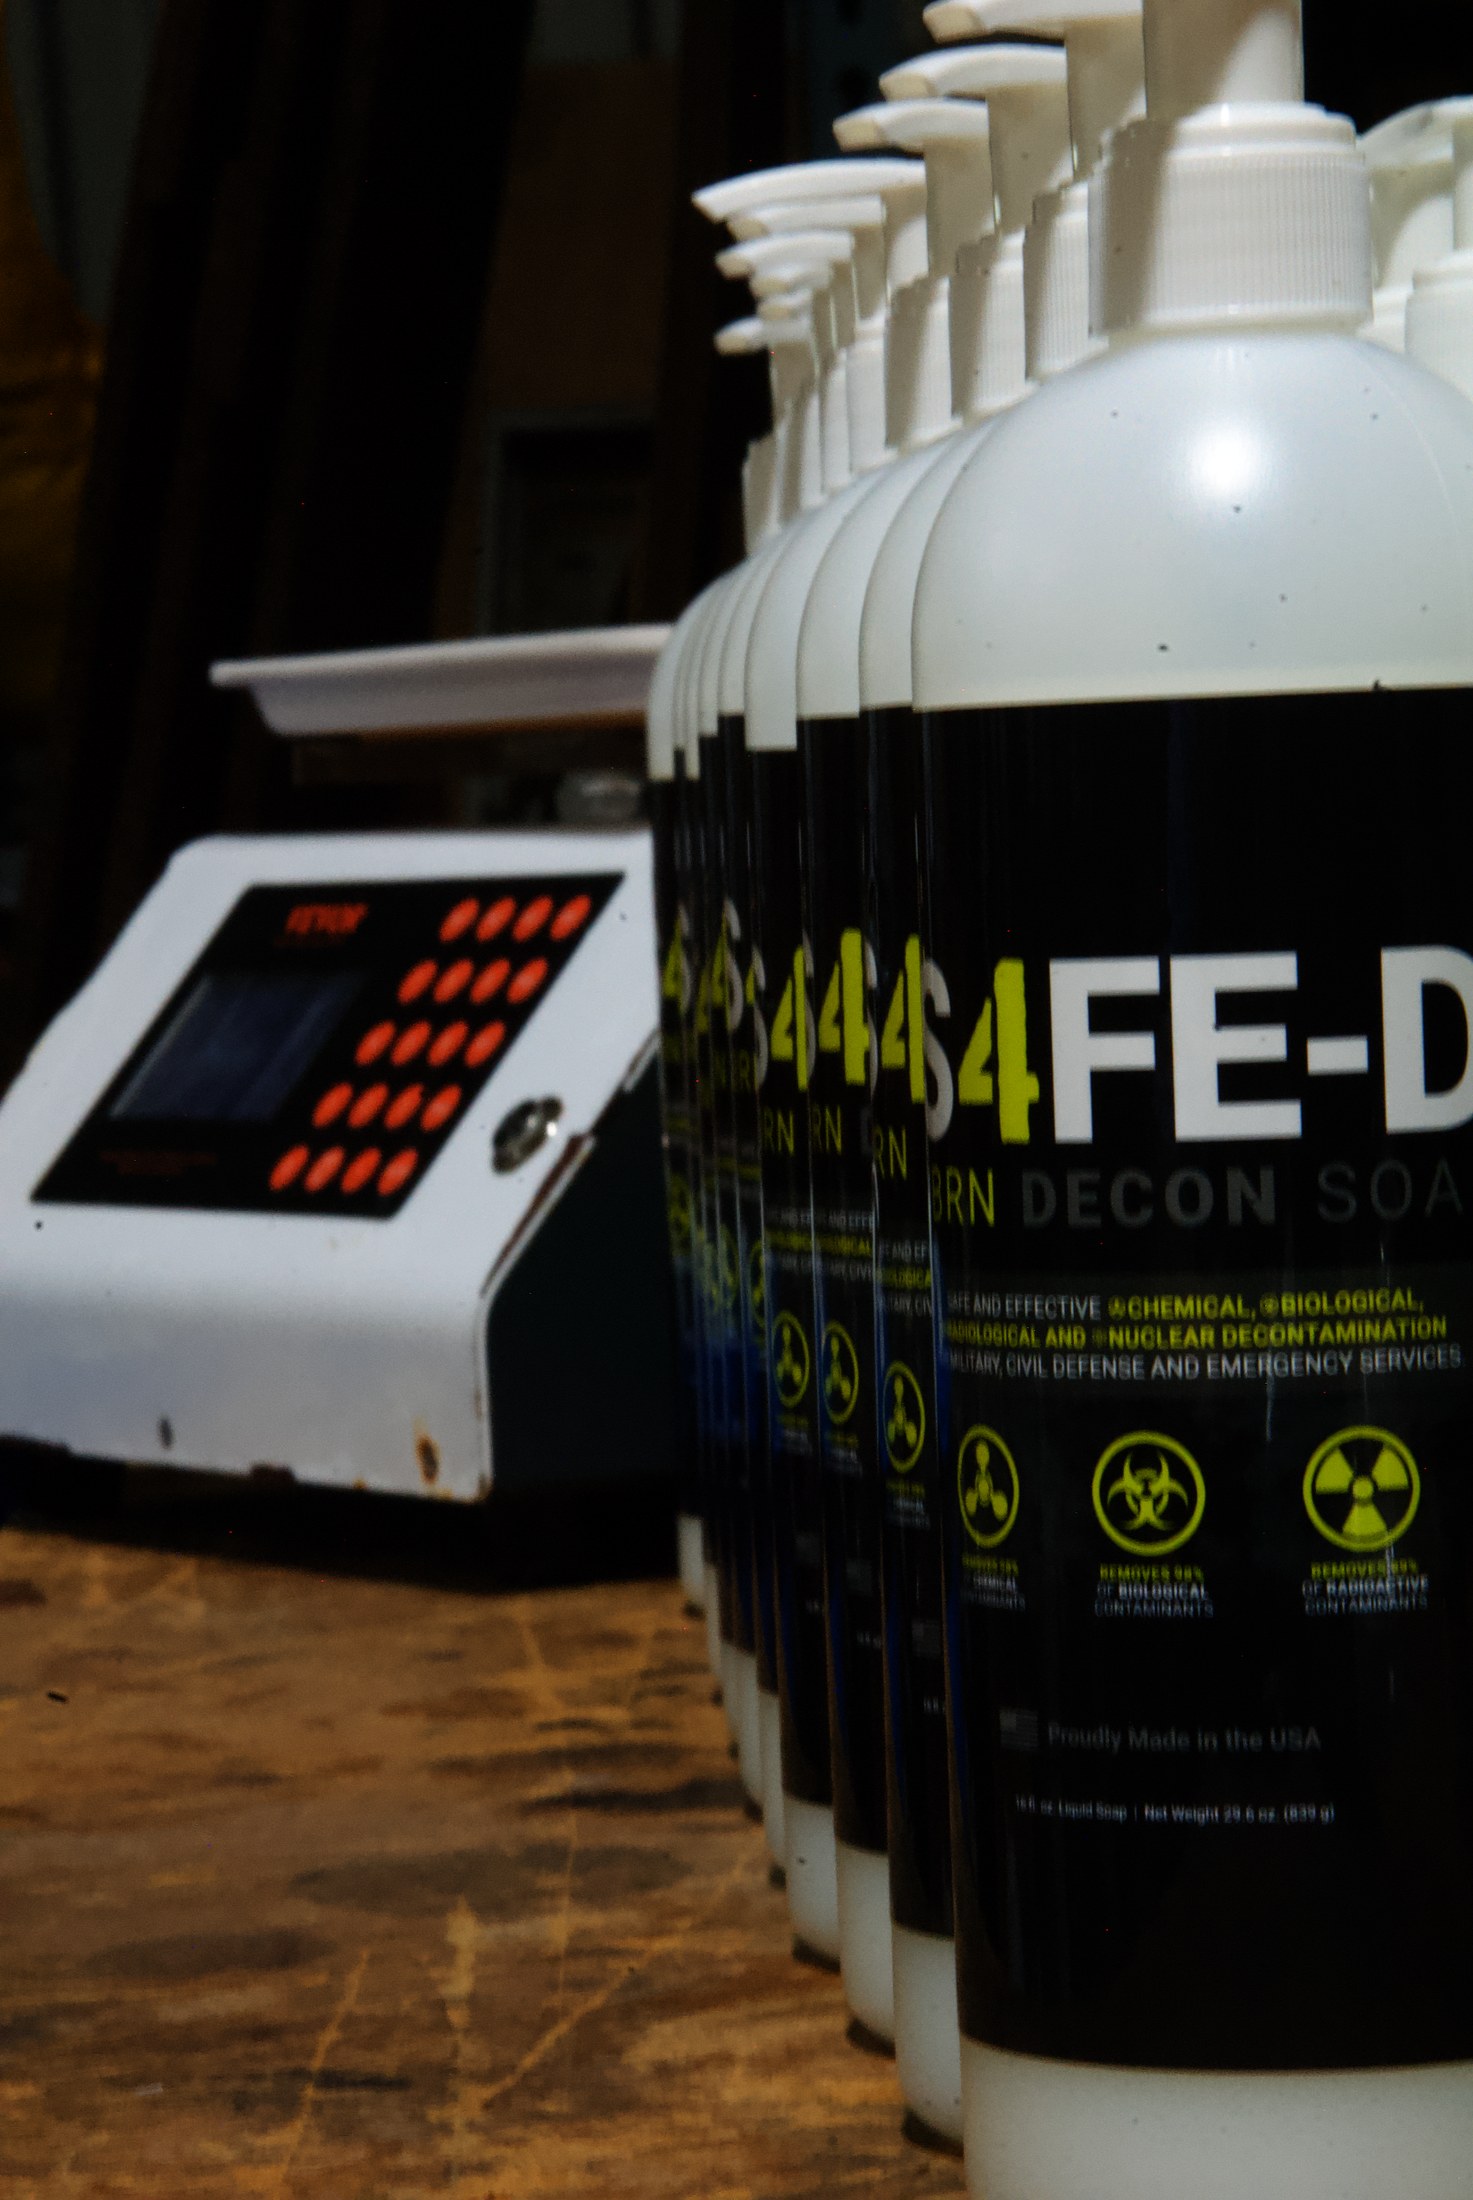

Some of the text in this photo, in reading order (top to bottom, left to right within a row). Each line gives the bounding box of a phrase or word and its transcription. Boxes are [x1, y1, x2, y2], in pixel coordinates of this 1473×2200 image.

[1021, 1163, 1277, 1230] DECON
[1316, 1156, 1464, 1224] SOA
[974, 1291, 1001, 1319] AND
[1005, 1293, 1102, 1321] EFFECTIVE
[1128, 1293, 1256, 1321] CHEMICAL,
[1281, 1287, 1424, 1318] BIOLOGICAL,
[1045, 1323, 1087, 1350] AND
[1108, 1322, 1215, 1350] NUCLEAR
[1221, 1315, 1447, 1350] DECONTAMINATION
[1006, 1351, 1048, 1379] CIVIL
[1053, 1352, 1145, 1381] DEFENSE
[1151, 1353, 1200, 1381] AND
[1206, 1350, 1353, 1380] EMERGENCY
[1099, 1562, 1171, 1582] REMOVES
[1326, 1572, 1430, 1601] RADIOACTIVE
[1118, 1580, 1208, 1601] BIOLOGICAL
[1094, 1598, 1215, 1618] CONTAMINANTS
[1048, 1721, 1323, 1755] Proudly Made in the USA
[1144, 1801, 1168, 1824] Net
[1171, 1802, 1219, 1829] Weight
